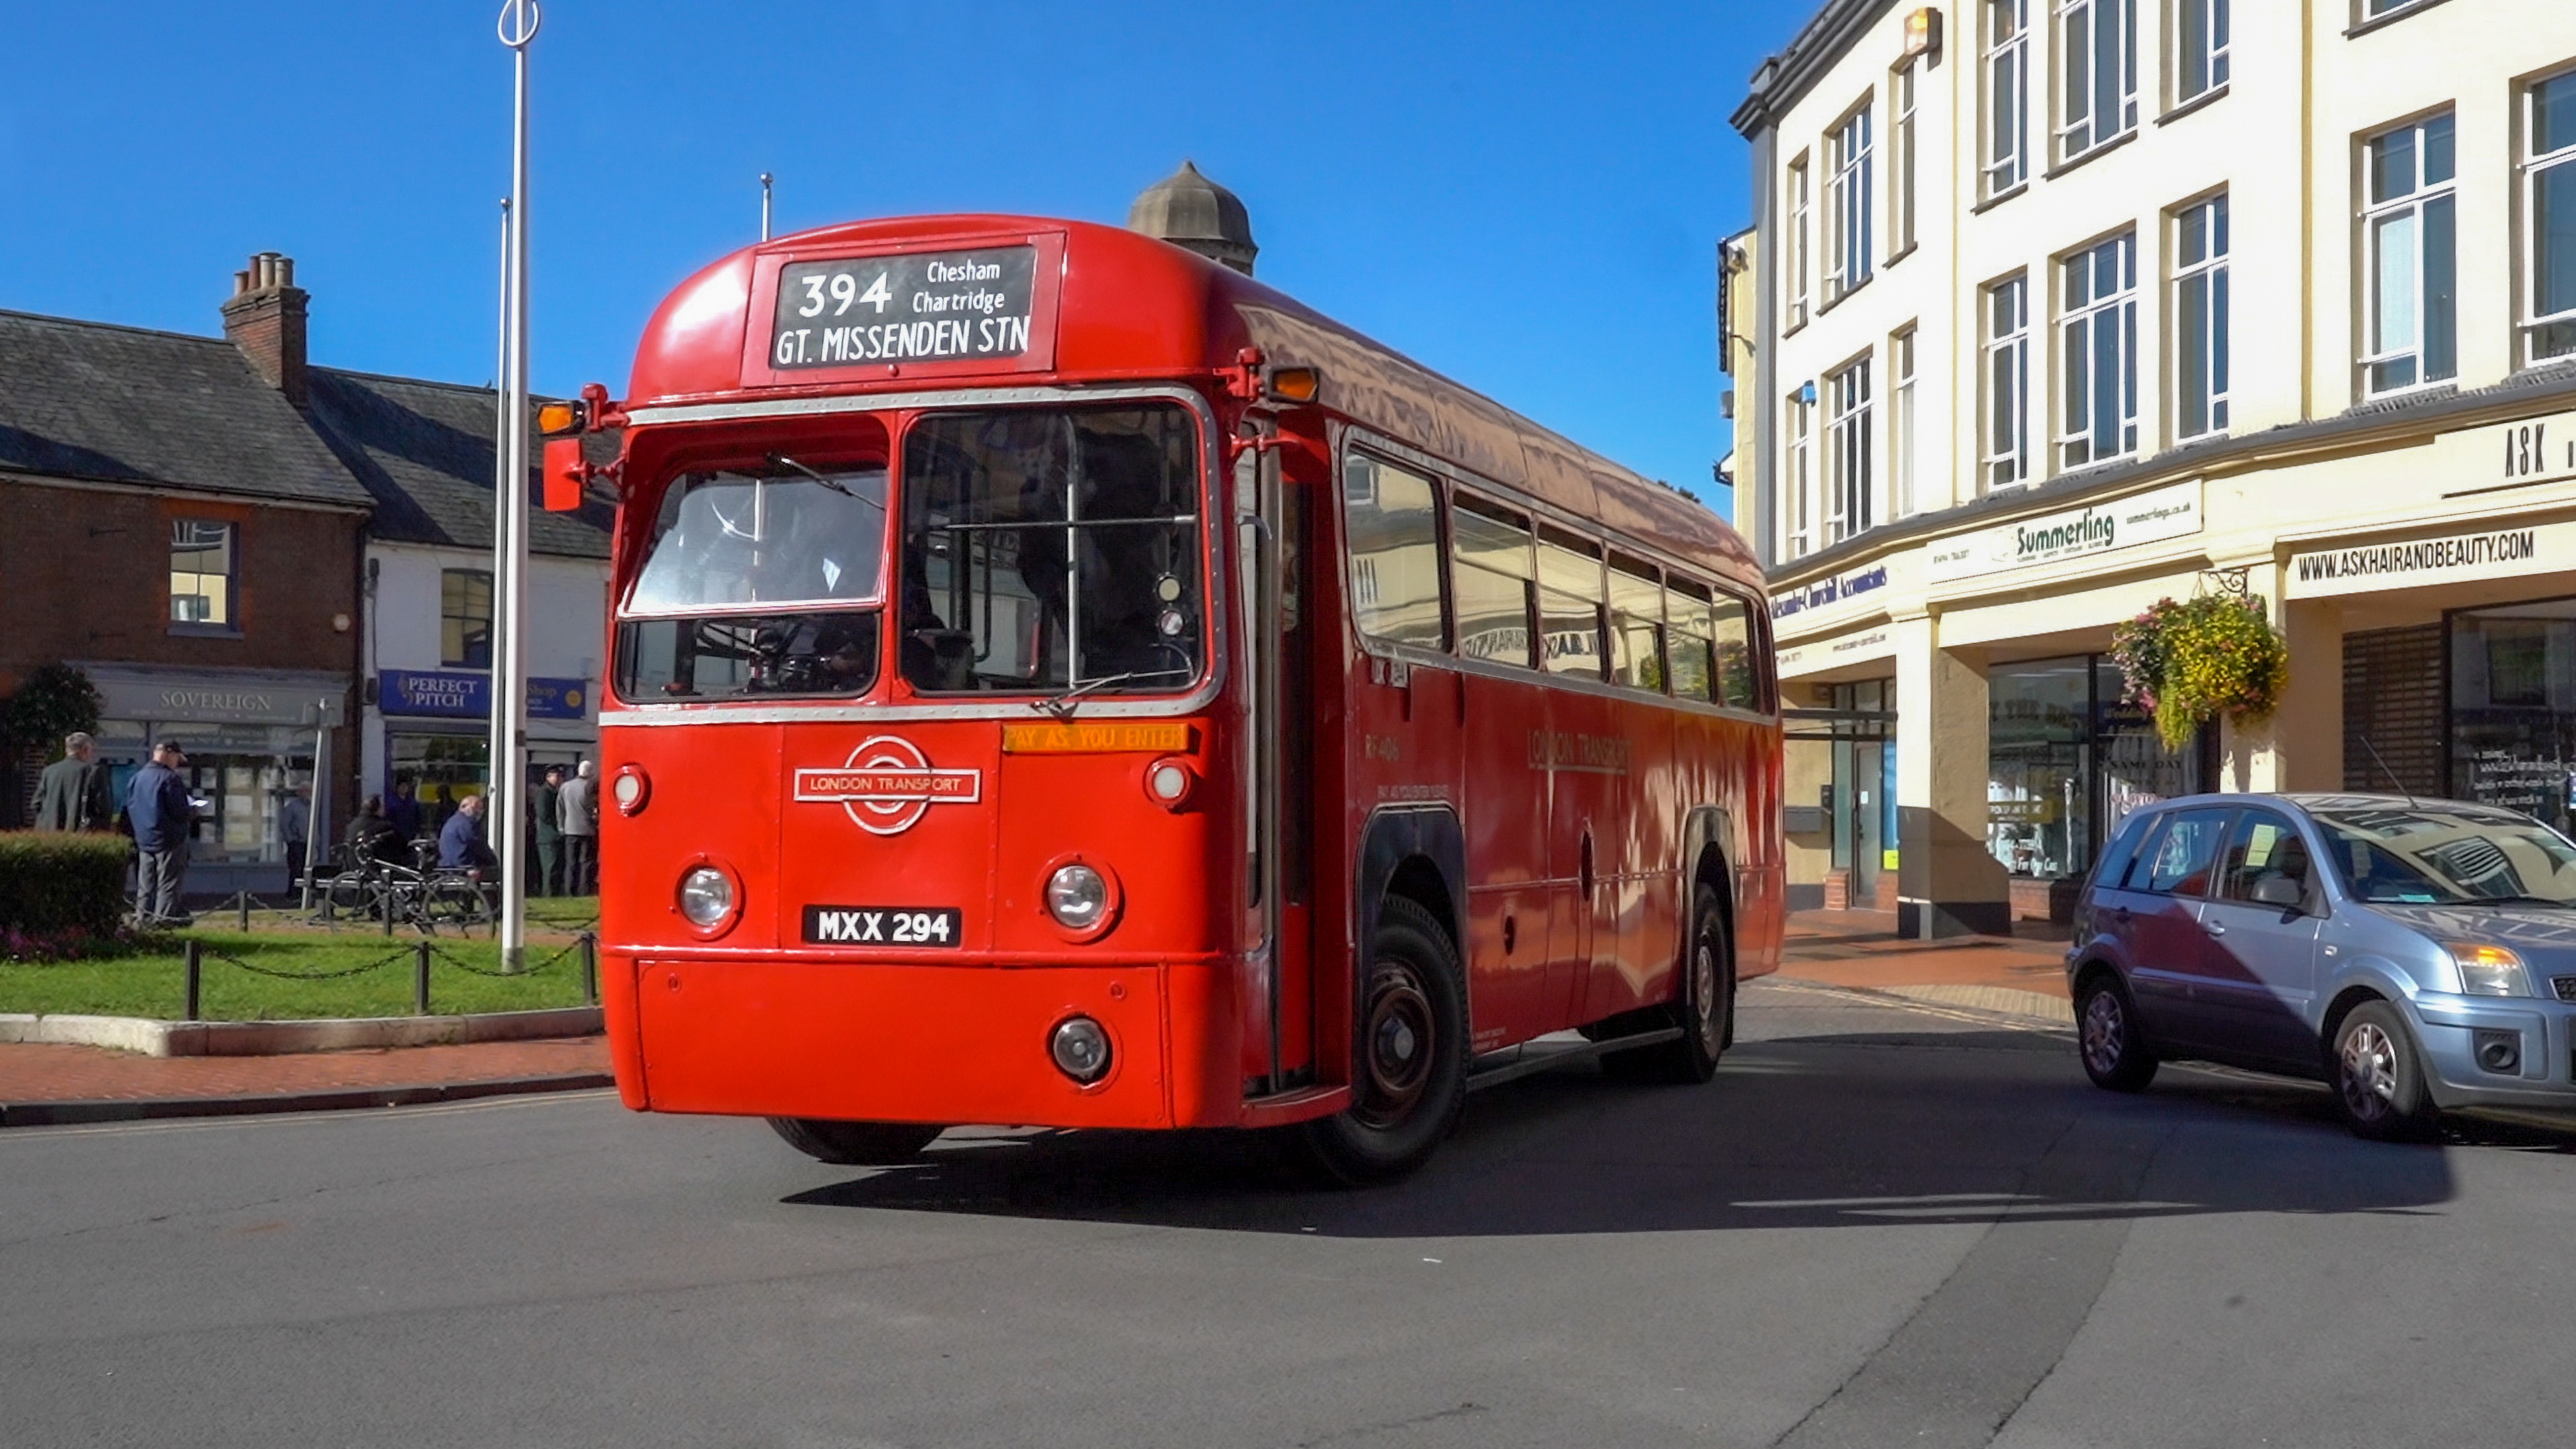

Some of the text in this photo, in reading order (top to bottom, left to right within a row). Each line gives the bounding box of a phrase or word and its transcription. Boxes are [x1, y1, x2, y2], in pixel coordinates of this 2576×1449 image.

[926, 259, 1000, 284] Chesham
[798, 272, 892, 318] 394
[912, 287, 1005, 314] Chartridge
[777, 315, 1030, 364] GT. MISSENDEN STN
[2505, 423, 2545, 478] ASK
[2017, 506, 2115, 555] Summerling
[2298, 530, 2534, 582] WWW.ASKHAIRANDBEAUTY.COM
[409, 678, 478, 694] PERFECT
[160, 691, 272, 710] SOVEREIGN
[415, 692, 466, 708] PITCH
[1045, 729, 1071, 747] AS
[1079, 728, 1115, 747] YOU
[1125, 728, 1181, 747] ENTER
[810, 777, 962, 792] LONDON TRANSPORT
[818, 911, 950, 942] MXX 294
